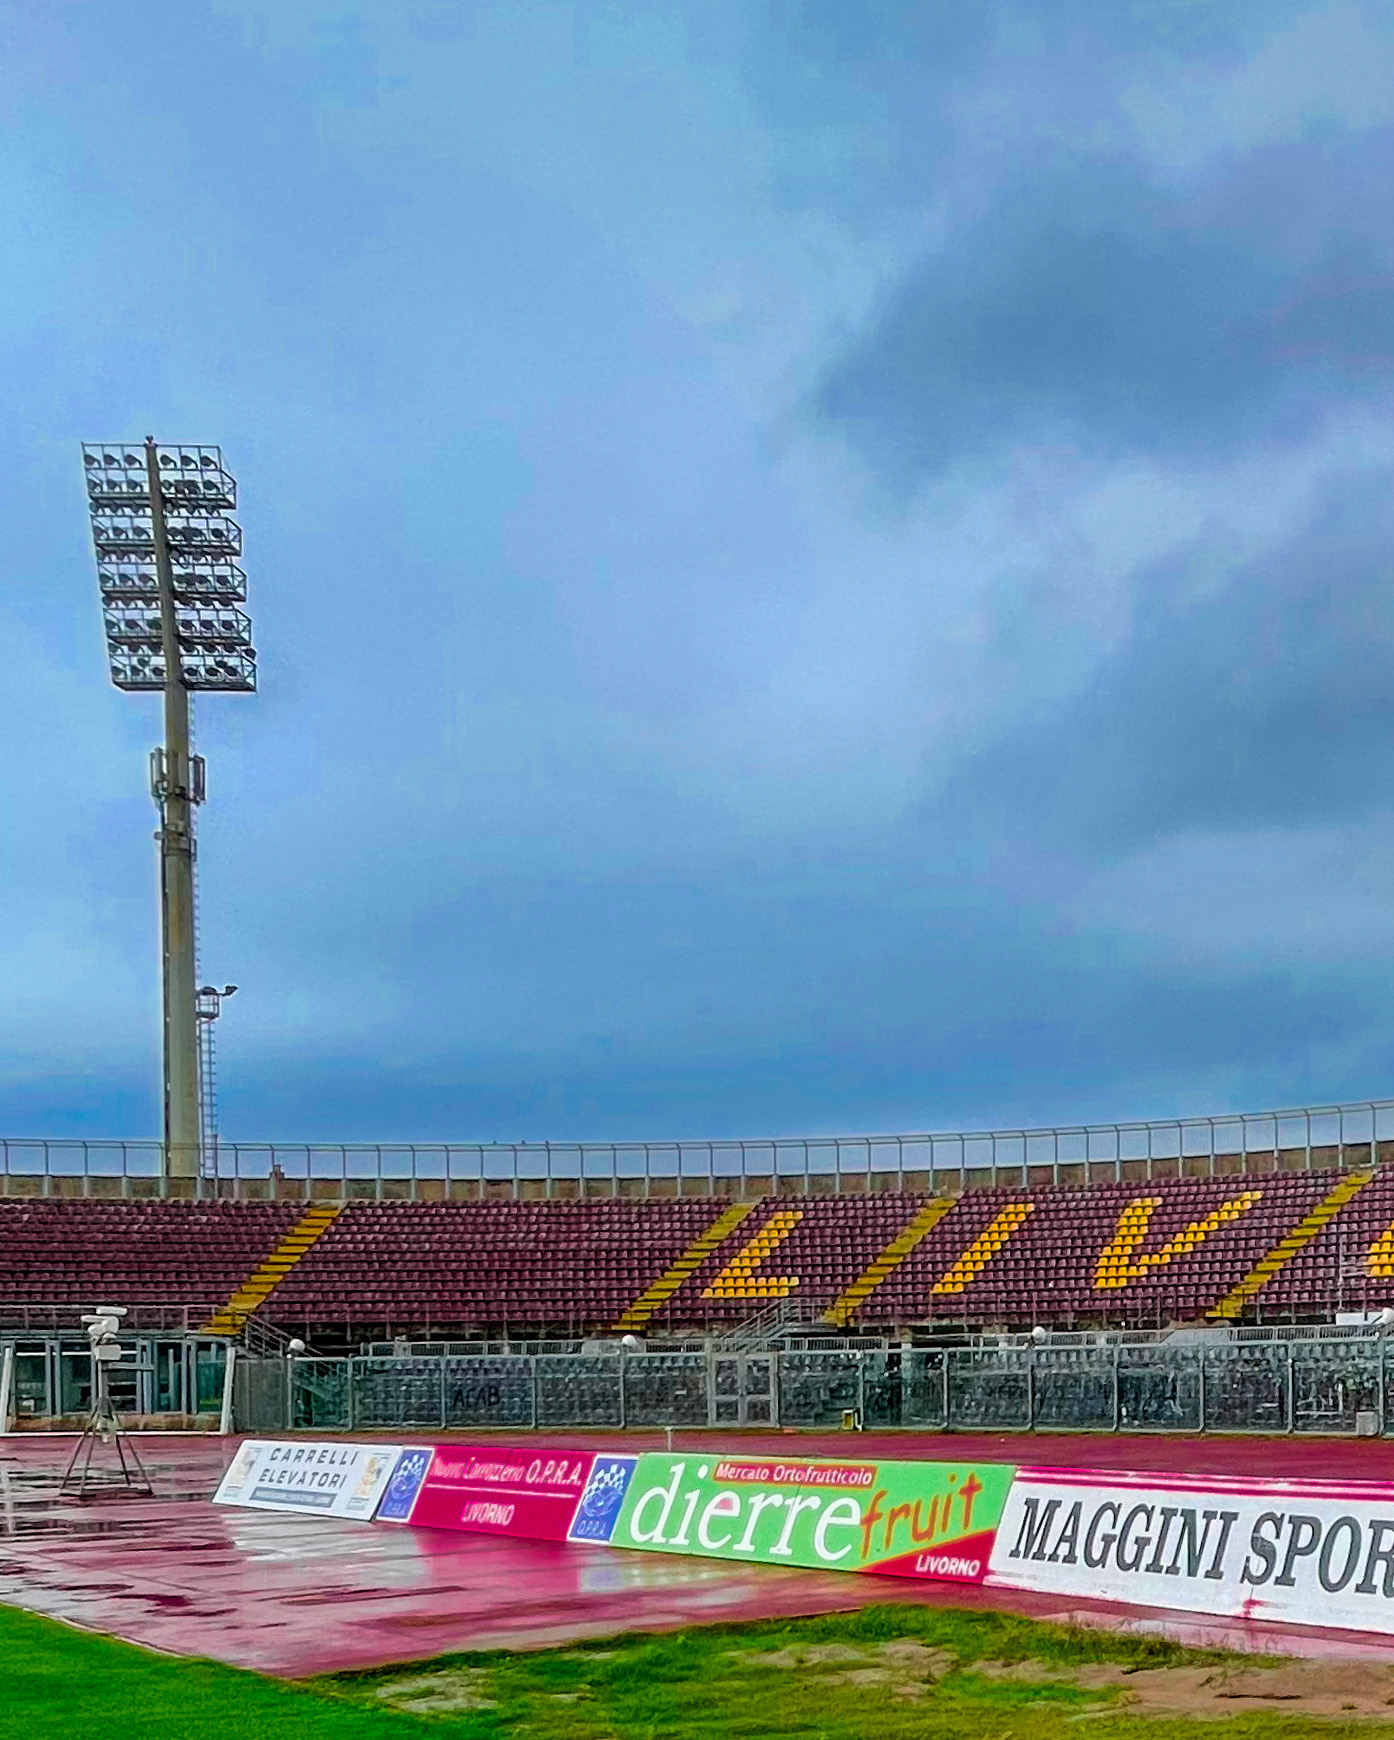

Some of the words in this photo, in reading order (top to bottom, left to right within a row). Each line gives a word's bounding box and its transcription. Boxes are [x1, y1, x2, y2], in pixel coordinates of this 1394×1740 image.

[269, 1448, 359, 1466] CARRELLI
[258, 1468, 348, 1489] ELEVATORI
[526, 1459, 582, 1486] O.P.R.A.
[716, 1463, 769, 1480] Mercato
[773, 1465, 872, 1485] Ortofrutticolo
[461, 1501, 515, 1526] LIVORNO
[1008, 1497, 1239, 1580] MAGGINI
[915, 1554, 981, 1577] LIVORNO
